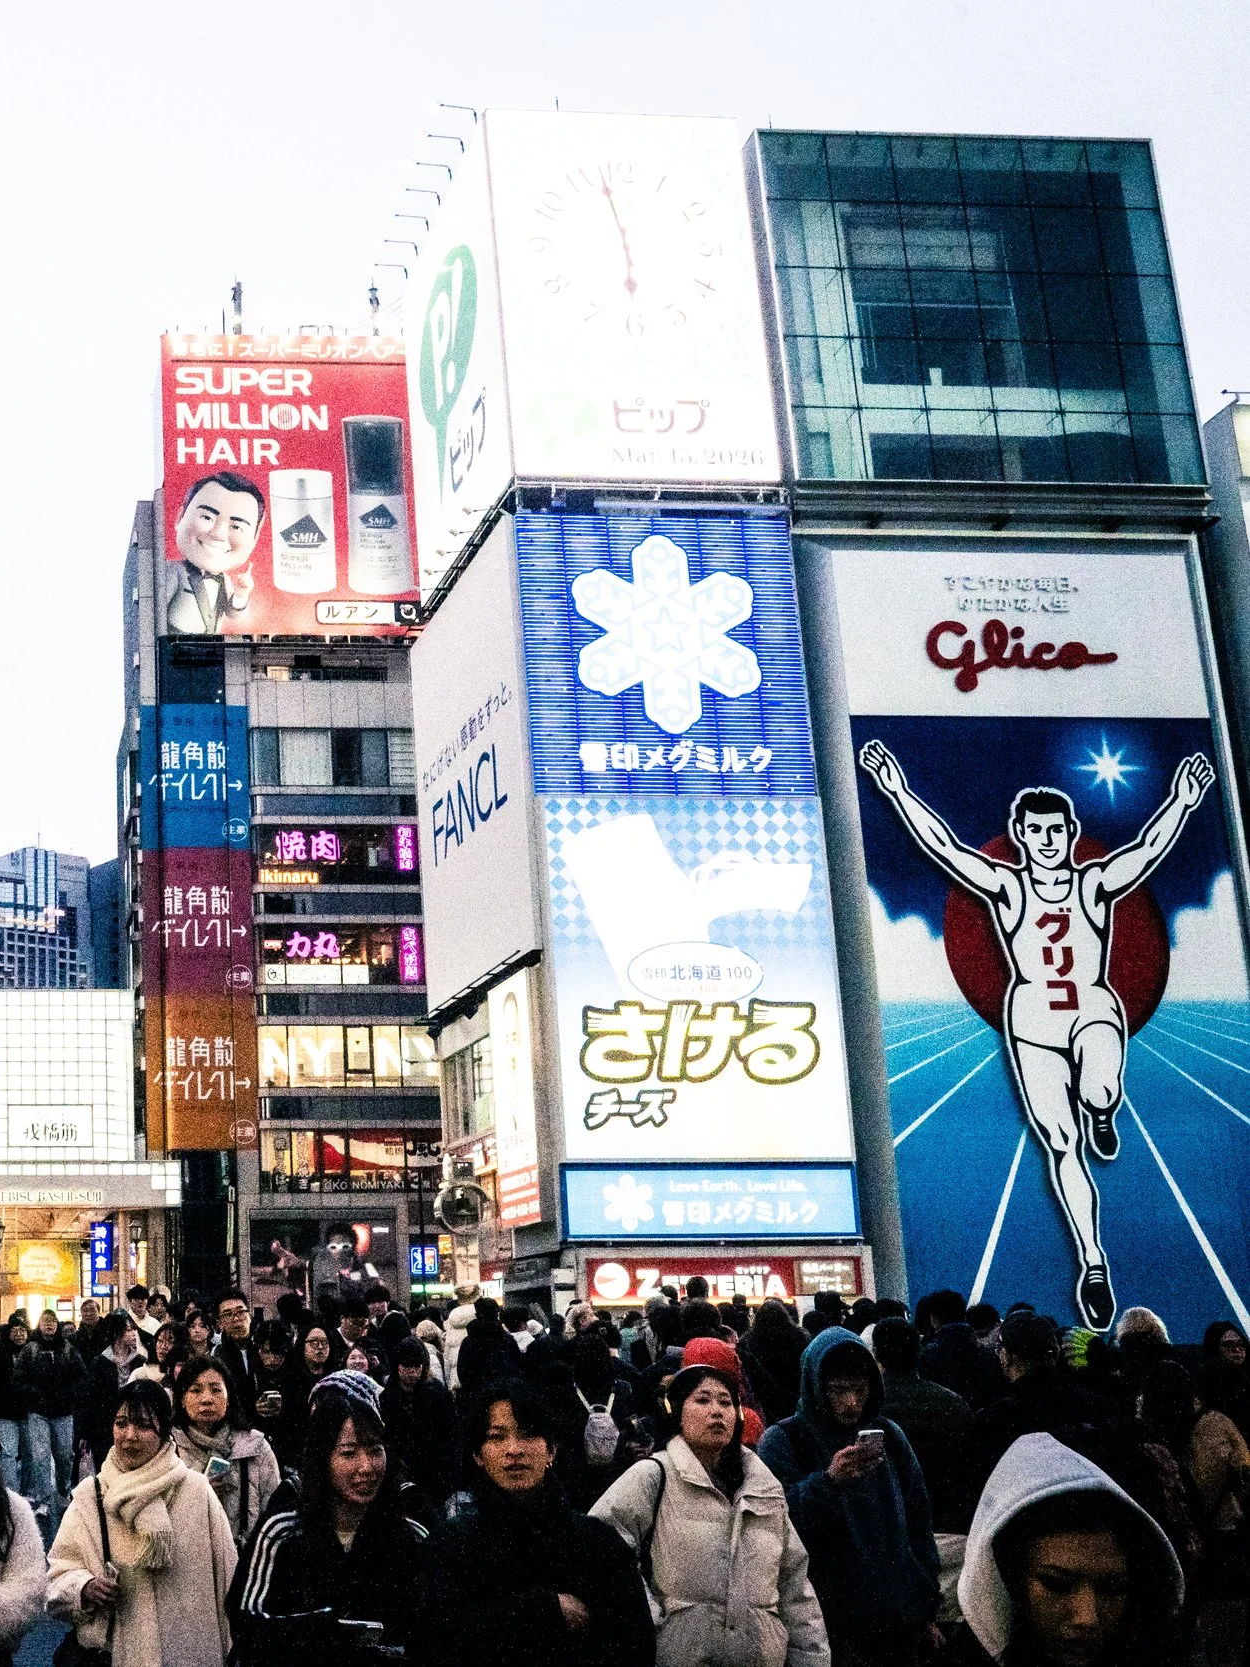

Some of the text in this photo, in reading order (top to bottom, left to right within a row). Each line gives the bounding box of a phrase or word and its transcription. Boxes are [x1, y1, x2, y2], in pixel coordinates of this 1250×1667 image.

[175, 367, 313, 396] SUPER
[176, 403, 329, 431] MILLION
[613, 397, 710, 434] ピップ
[177, 437, 281, 465] HAIR
[291, 533, 319, 543] SMH
[325, 605, 378, 619] ルアン
[926, 618, 1118, 692] Glico
[161, 741, 229, 770] 龍角散
[579, 740, 773, 773] 雪印メグミルク
[432, 743, 508, 868] FANCL
[275, 830, 340, 861] 焼肉
[164, 886, 233, 915] 龍角散
[286, 931, 340, 958] 力丸
[1035, 907, 1079, 1010] グリコ
[670, 965, 721, 980] 北海道
[728, 966, 752, 978] 100
[165, 1036, 236, 1067] 龍角散
[580, 998, 820, 1085] さける
[583, 1088, 677, 1130] チーズ
[23, 1122, 78, 1141] 戎橋筋
[670, 1180, 699, 1192] Love
[747, 1180, 778, 1192] Love
[662, 1196, 819, 1226] 雪印メグミルク
